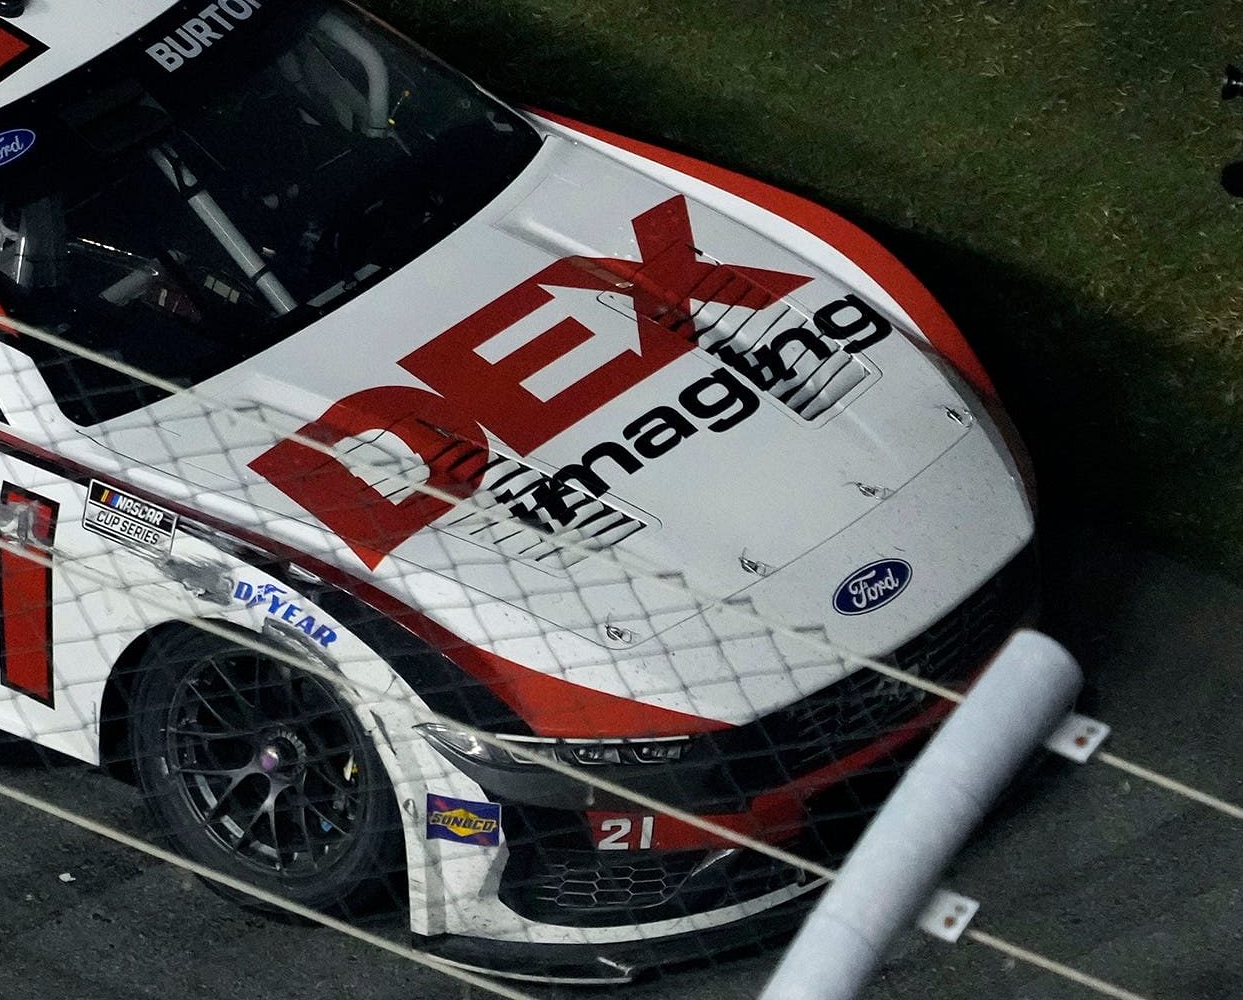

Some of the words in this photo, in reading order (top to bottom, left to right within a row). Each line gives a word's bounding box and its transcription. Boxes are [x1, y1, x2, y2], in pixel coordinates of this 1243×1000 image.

[246, 194, 815, 572] DEX
[495, 293, 893, 534] imaging
[96, 511, 120, 528] CUP
[120, 520, 160, 545] SERIES
[115, 495, 164, 525] NASCAR
[848, 567, 899, 608] Ford
[234, 581, 338, 648] DYEAR
[430, 811, 497, 833] SUNOCO
[598, 816, 654, 851] 21
